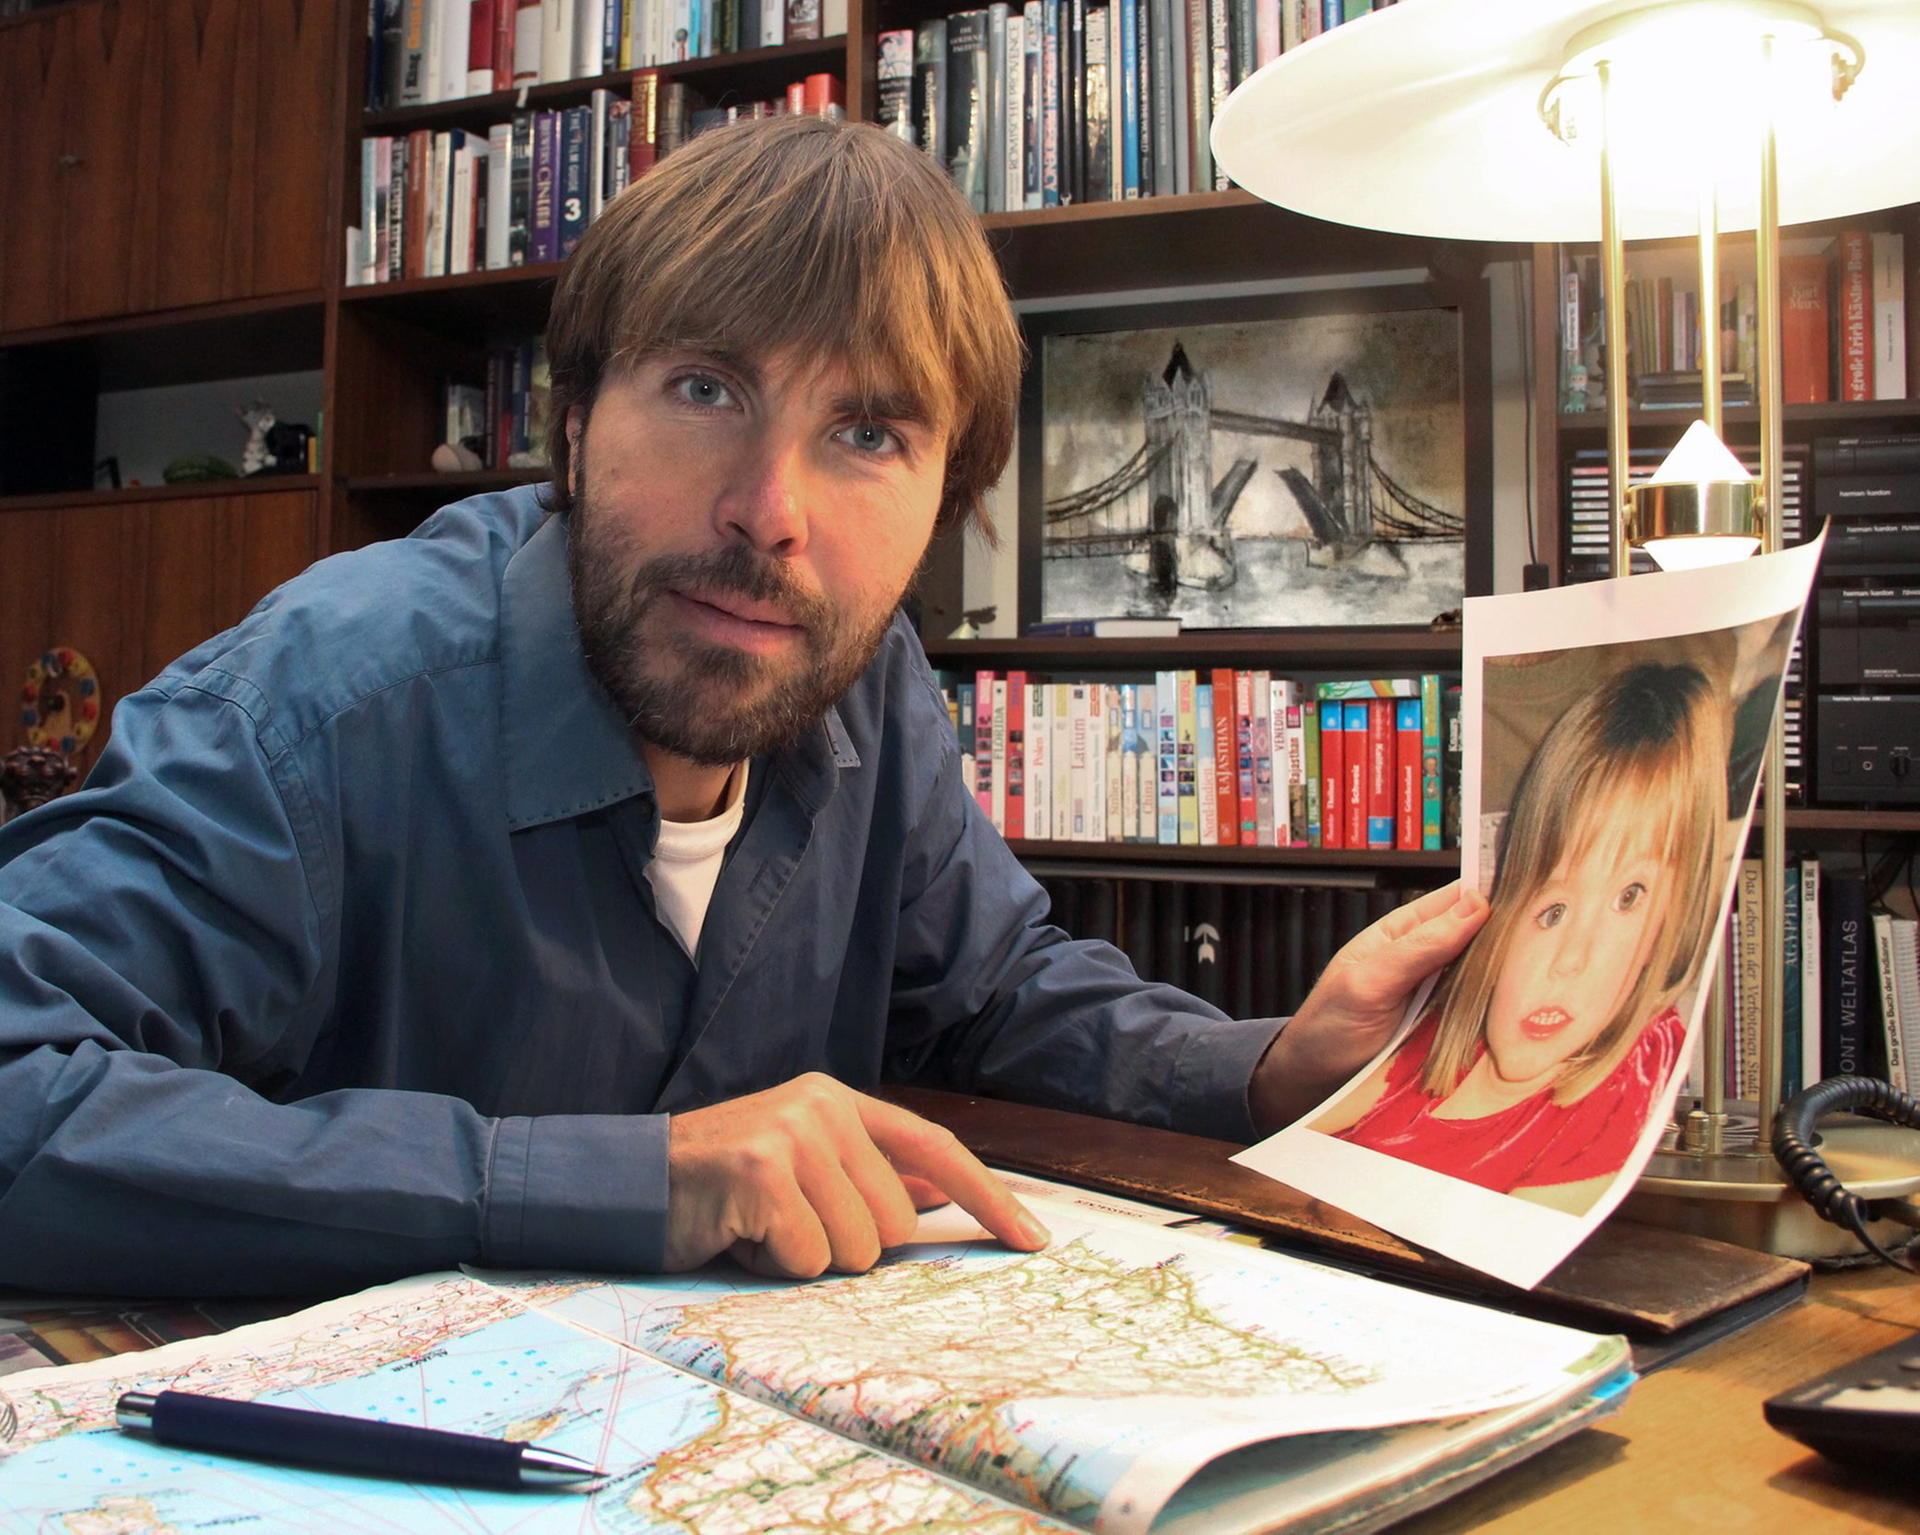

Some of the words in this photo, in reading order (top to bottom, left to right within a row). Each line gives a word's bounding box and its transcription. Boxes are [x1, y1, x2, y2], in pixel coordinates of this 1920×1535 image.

[1008, 25, 1019, 94] PROVENCE
[570, 112, 582, 130] THE
[567, 164, 580, 192] GUIDE
[564, 197, 582, 222] 3
[1848, 273, 1863, 321] Kästner
[1848, 322, 1864, 355] Erich
[1850, 358, 1865, 391] große
[994, 706, 1005, 760] FLORIDA
[1071, 718, 1086, 770] Latium
[1274, 708, 1285, 752] VENEDIG
[1033, 736, 1044, 766] Polen
[1216, 716, 1232, 795] RAJASTHAN
[1289, 736, 1302, 784] Rajasthan
[1142, 780, 1153, 815] China
[1326, 778, 1335, 809] Thailand
[1351, 764, 1360, 804] Schweiz
[1202, 768, 1216, 838] Nord-Indien
[1745, 869, 1758, 894] Das
[1745, 900, 1759, 938] Leben
[1746, 942, 1759, 955] in
[1880, 936, 1891, 975] Indianer
[1746, 959, 1760, 979] der
[1841, 920, 1859, 1027] WELTATLAS
[1883, 974, 1893, 992] der
[1746, 985, 1760, 1056] Verbotenen
[1885, 993, 1895, 1018] Buch
[1887, 1018, 1899, 1047] große
[1890, 1047, 1900, 1067] Das
[1746, 1061, 1759, 1095] Stadt
